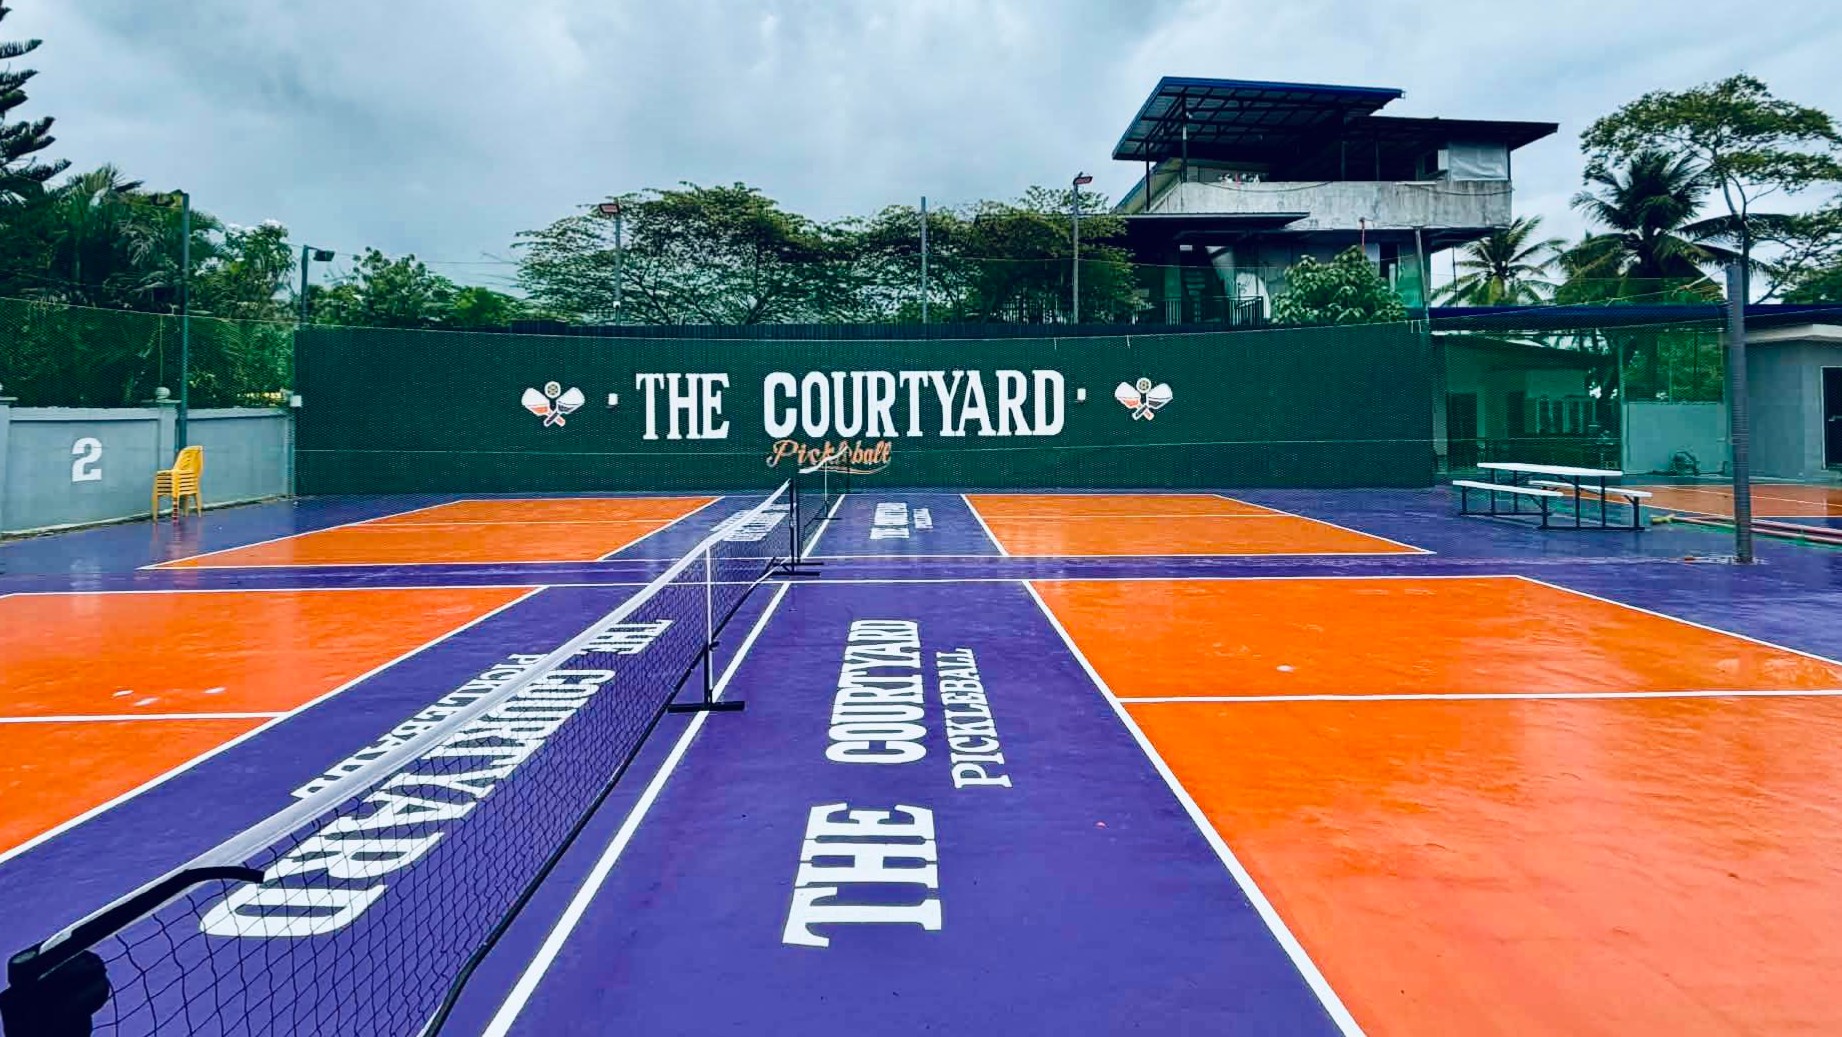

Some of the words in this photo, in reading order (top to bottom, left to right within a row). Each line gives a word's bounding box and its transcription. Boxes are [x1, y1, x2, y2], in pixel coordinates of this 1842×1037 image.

[71, 437, 102, 482] 2
[635, 373, 729, 440] THE
[763, 369, 1065, 438] COURTYARD
[825, 619, 927, 764] COURTYARD
[936, 648, 1013, 789] PICKLEBALL
[782, 803, 942, 947] THE
